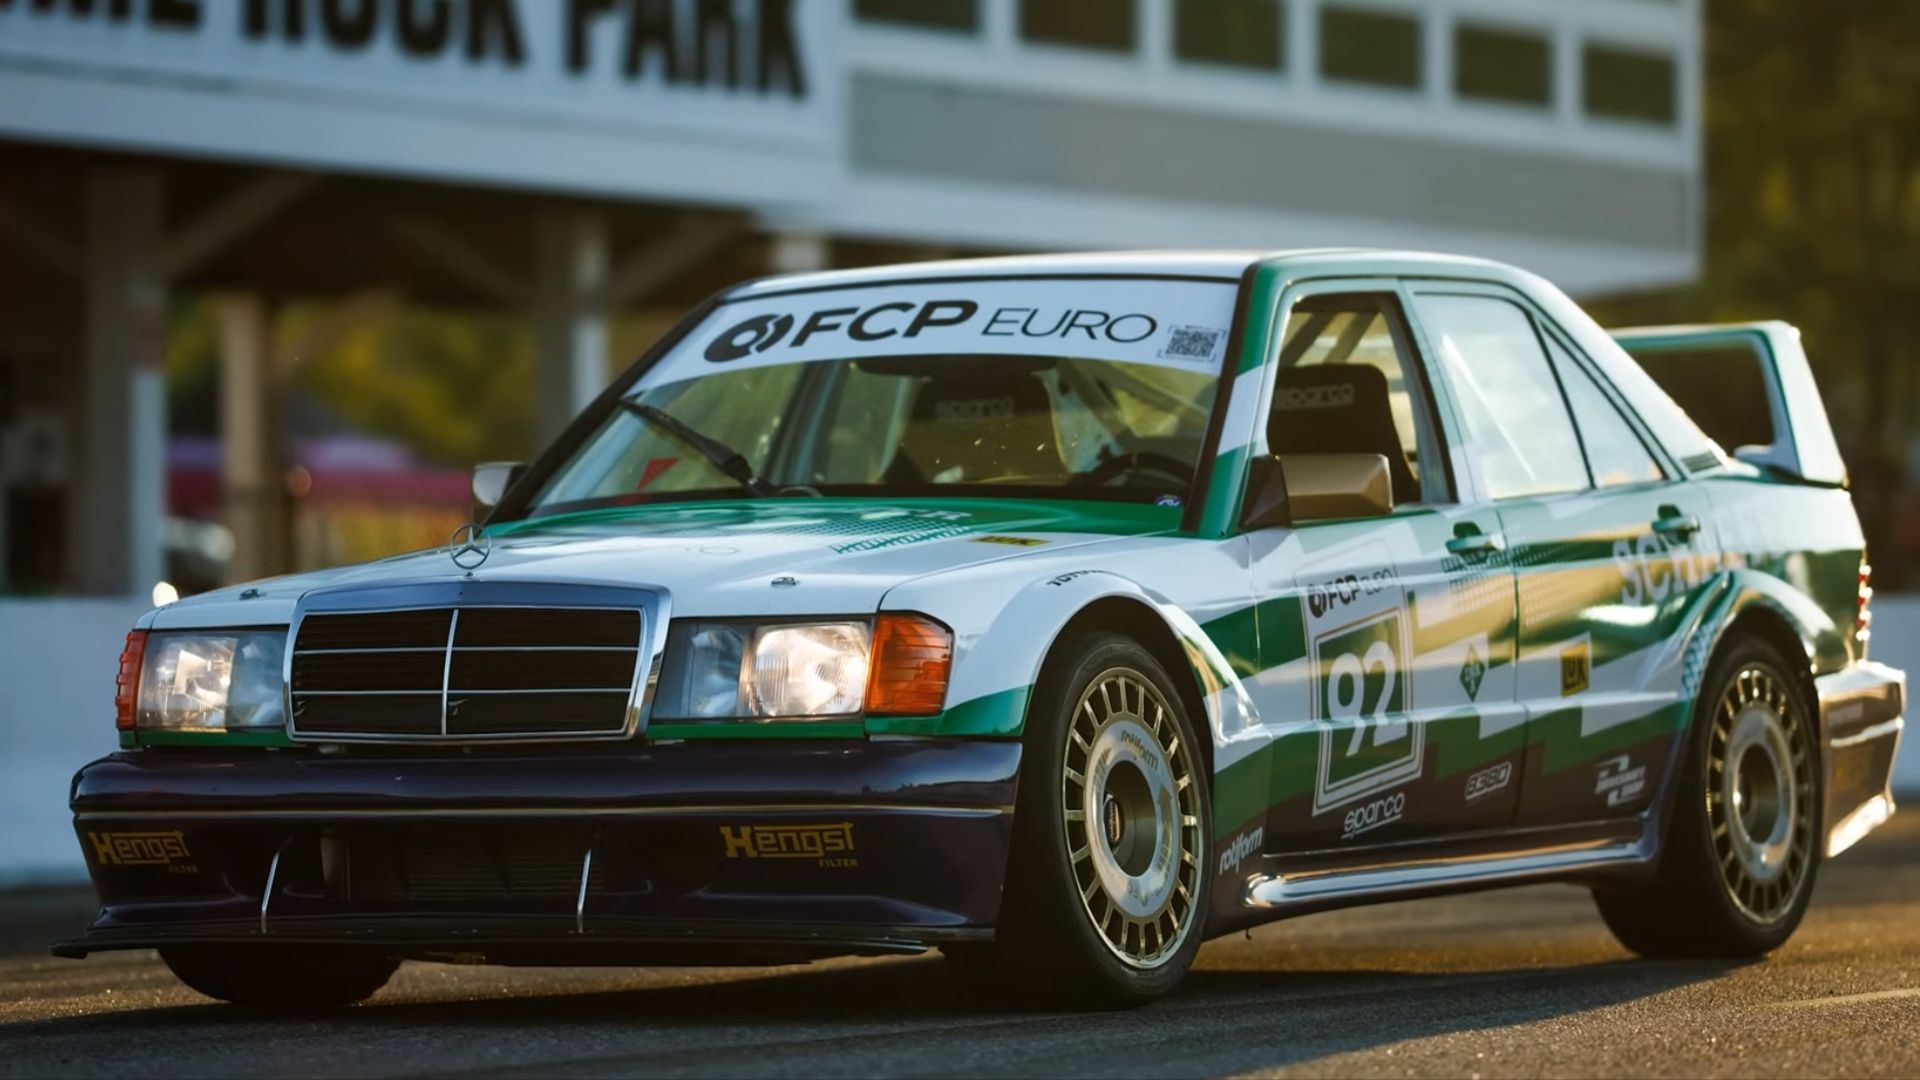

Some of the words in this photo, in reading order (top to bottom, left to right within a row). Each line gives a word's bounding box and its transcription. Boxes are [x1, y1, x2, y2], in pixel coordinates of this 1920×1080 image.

[790, 300, 979, 347] FCP
[981, 307, 1158, 344] EURO
[1328, 640, 1408, 757] 92
[1342, 792, 1405, 839] sparco
[87, 830, 191, 864] Hengst
[719, 822, 855, 858] Hengst
[818, 858, 858, 868] FILTER
[1219, 826, 1263, 874] rotiform
